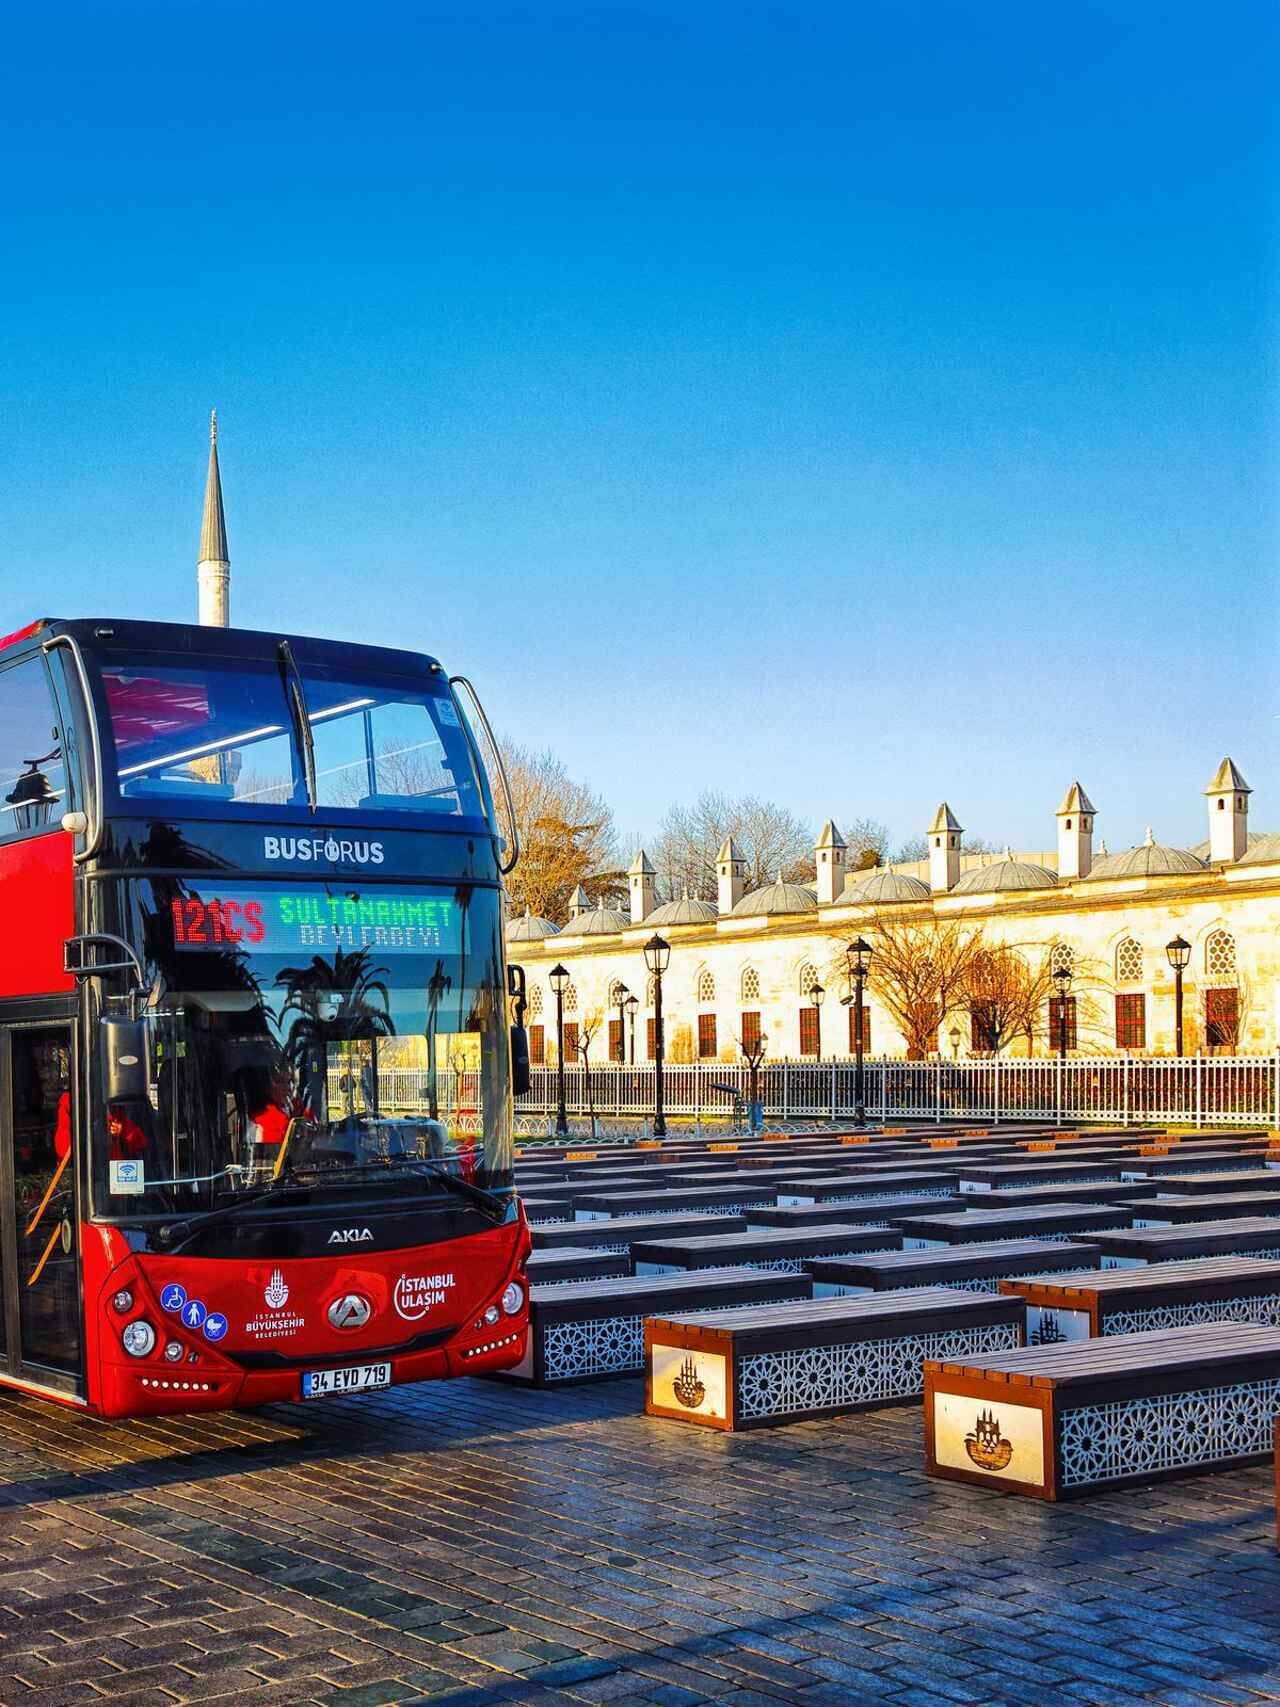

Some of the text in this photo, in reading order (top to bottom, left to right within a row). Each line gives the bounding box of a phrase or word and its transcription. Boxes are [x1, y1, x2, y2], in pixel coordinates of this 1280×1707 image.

[264, 836, 384, 864] BUSFORUS
[171, 897, 265, 943] 121CS
[279, 896, 452, 927] SULTANAHMET
[328, 1228, 375, 1244] AKIA
[401, 1274, 456, 1293] İSTANBUL
[401, 1291, 445, 1309] ULAŞIM
[245, 1317, 305, 1332] BÜYÜKŞEHİR
[312, 1373, 328, 1391] 34
[334, 1369, 359, 1388] EVD
[364, 1365, 386, 1384] 719
